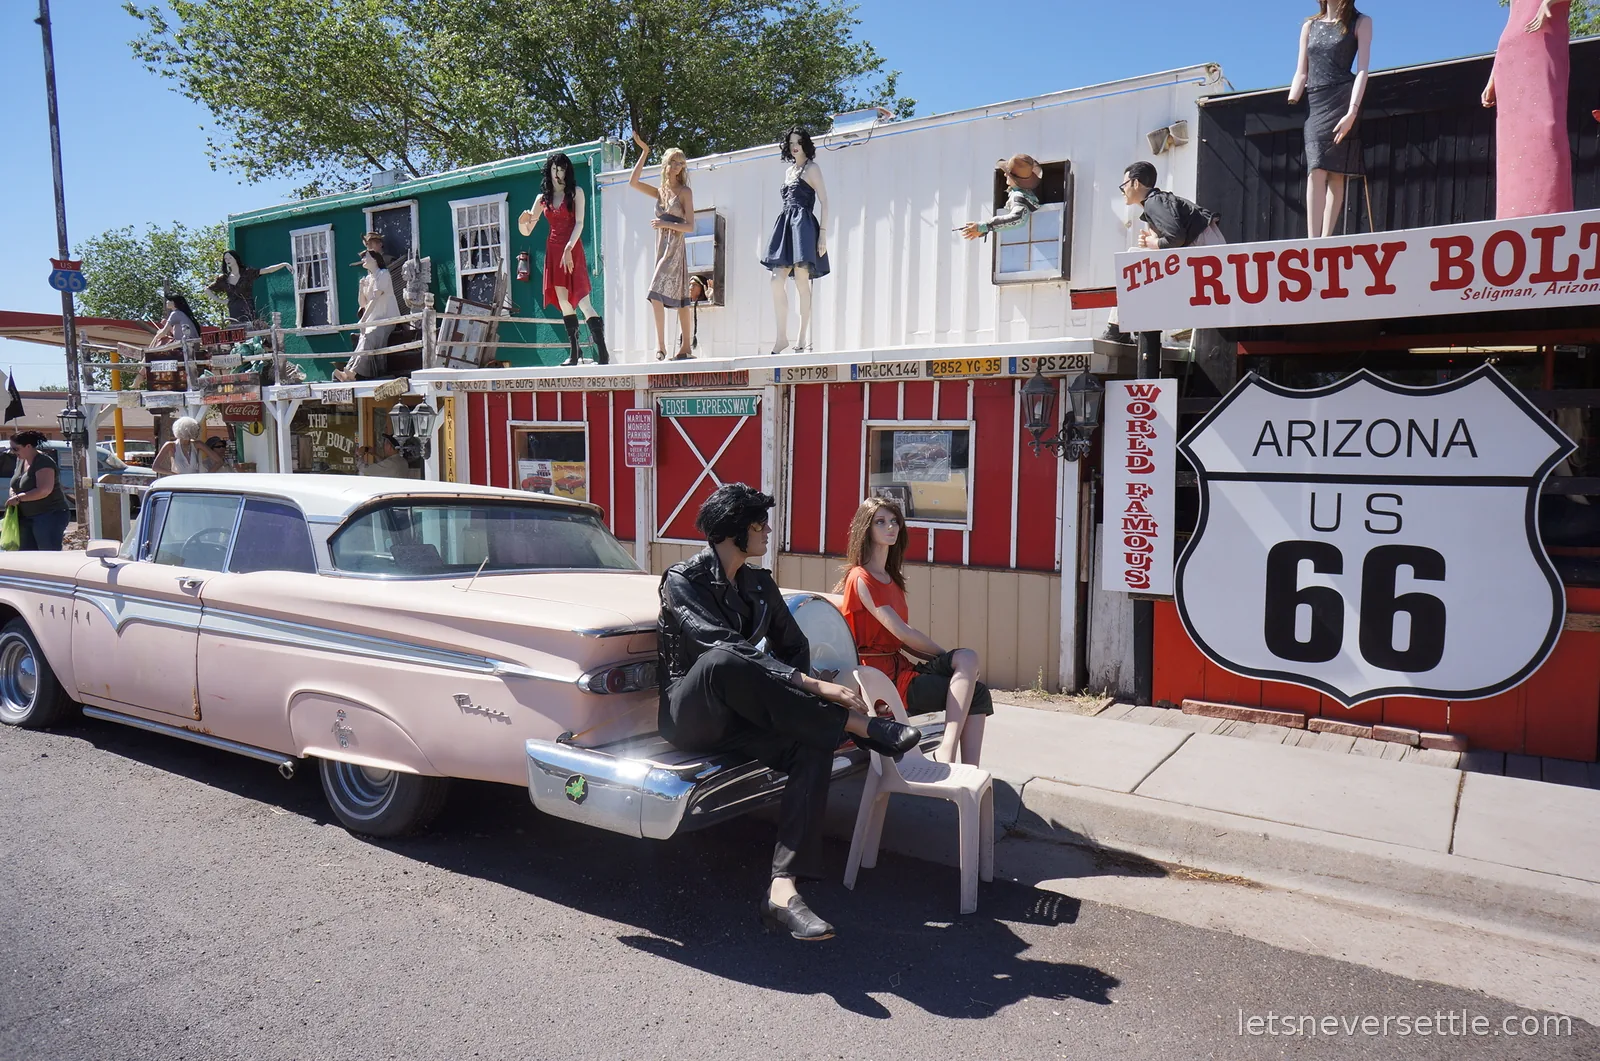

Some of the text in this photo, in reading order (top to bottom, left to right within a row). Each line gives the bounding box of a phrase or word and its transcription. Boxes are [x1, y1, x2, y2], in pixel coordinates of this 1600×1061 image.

[55, 271, 81, 290] 66
[1123, 253, 1181, 292] The
[1187, 241, 1407, 307] RUSTY
[1461, 282, 1600, 301] Seligman, Arizon
[933, 360, 1000, 374] 2852 YG 35
[1022, 355, 1084, 371] S PS 228
[653, 373, 684, 388] HARLEY
[687, 371, 728, 387] DAVIDSON
[787, 366, 829, 380] S PT 98
[858, 365, 871, 378] MR
[515, 379, 533, 389] 6075
[620, 377, 631, 387] 35
[666, 398, 749, 415] EDSEL EXPRESSWAY
[307, 413, 328, 429] THE
[627, 415, 651, 423] MARILYN
[627, 423, 651, 431] MONROE
[327, 431, 354, 454] BOLT
[627, 431, 651, 439] PARKING
[1252, 418, 1478, 458] ARIZONA
[1121, 384, 1162, 589] WORLD FAMOUS
[1264, 540, 1446, 673] 66
